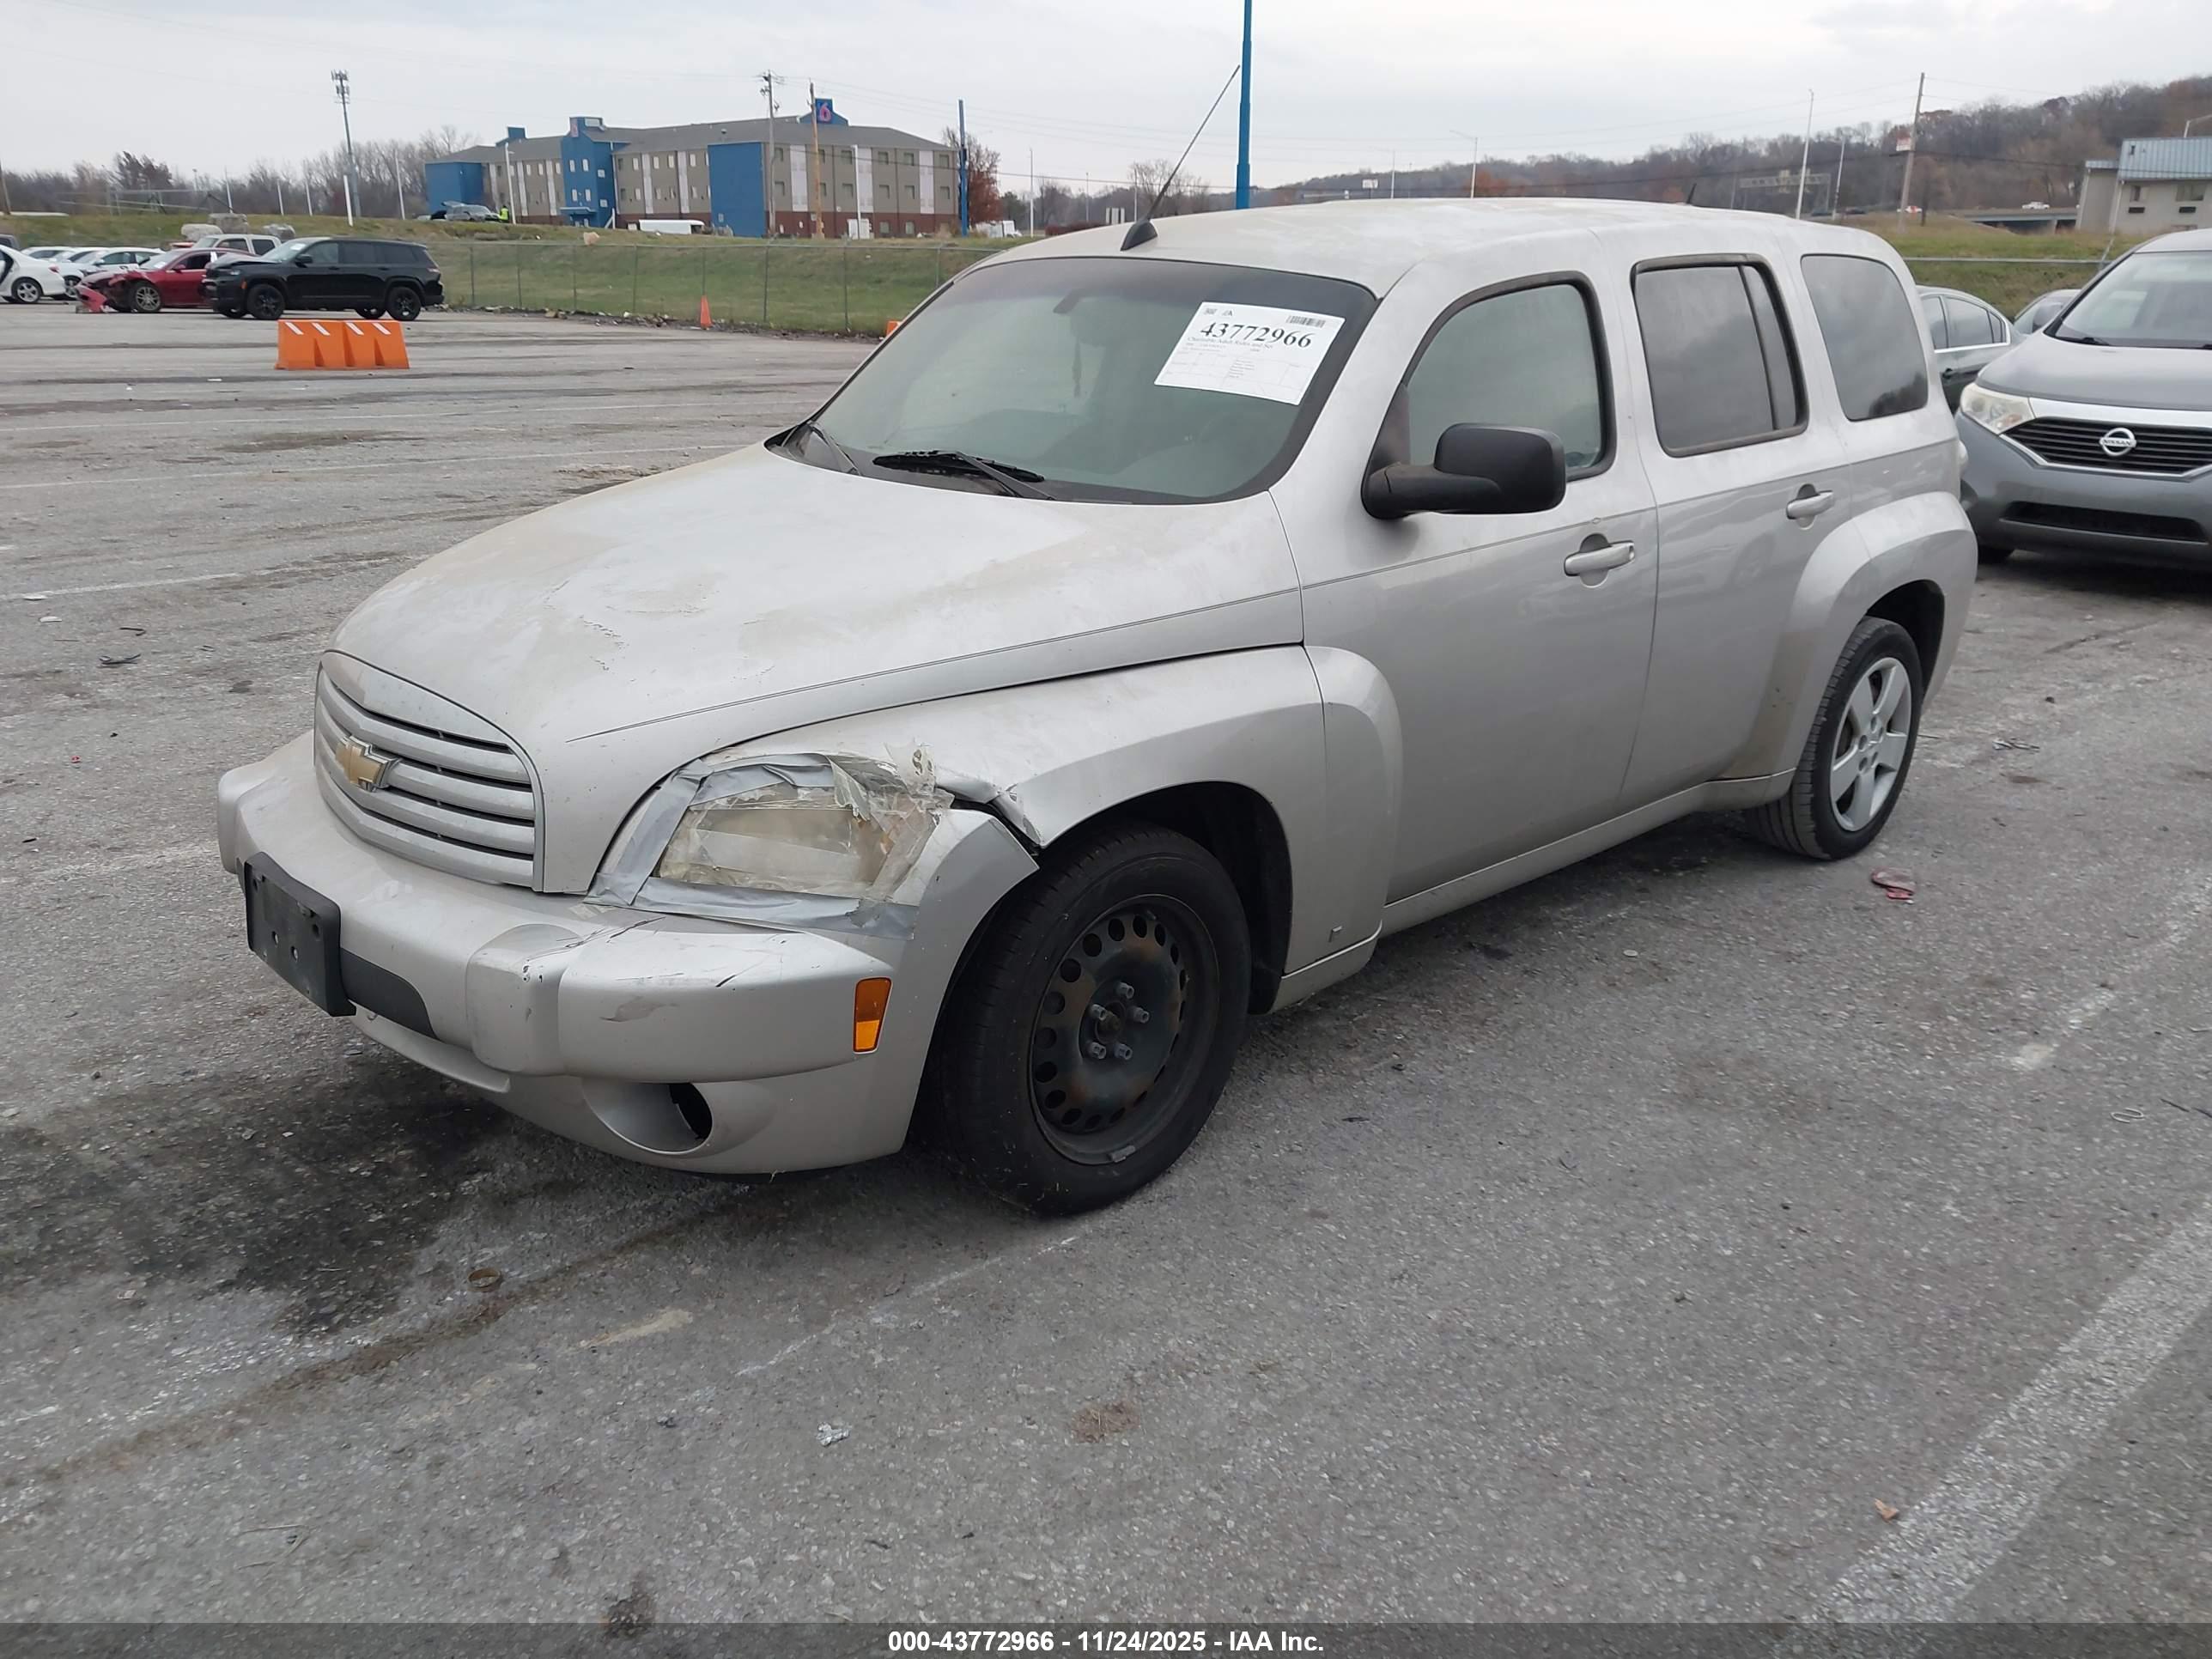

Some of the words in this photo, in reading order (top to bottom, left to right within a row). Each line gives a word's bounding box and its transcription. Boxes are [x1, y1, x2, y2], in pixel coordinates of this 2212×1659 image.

[819, 101, 832, 122] 6
[1200, 322, 1316, 348] 43772966
[2103, 438, 2131, 447] NISSAN
